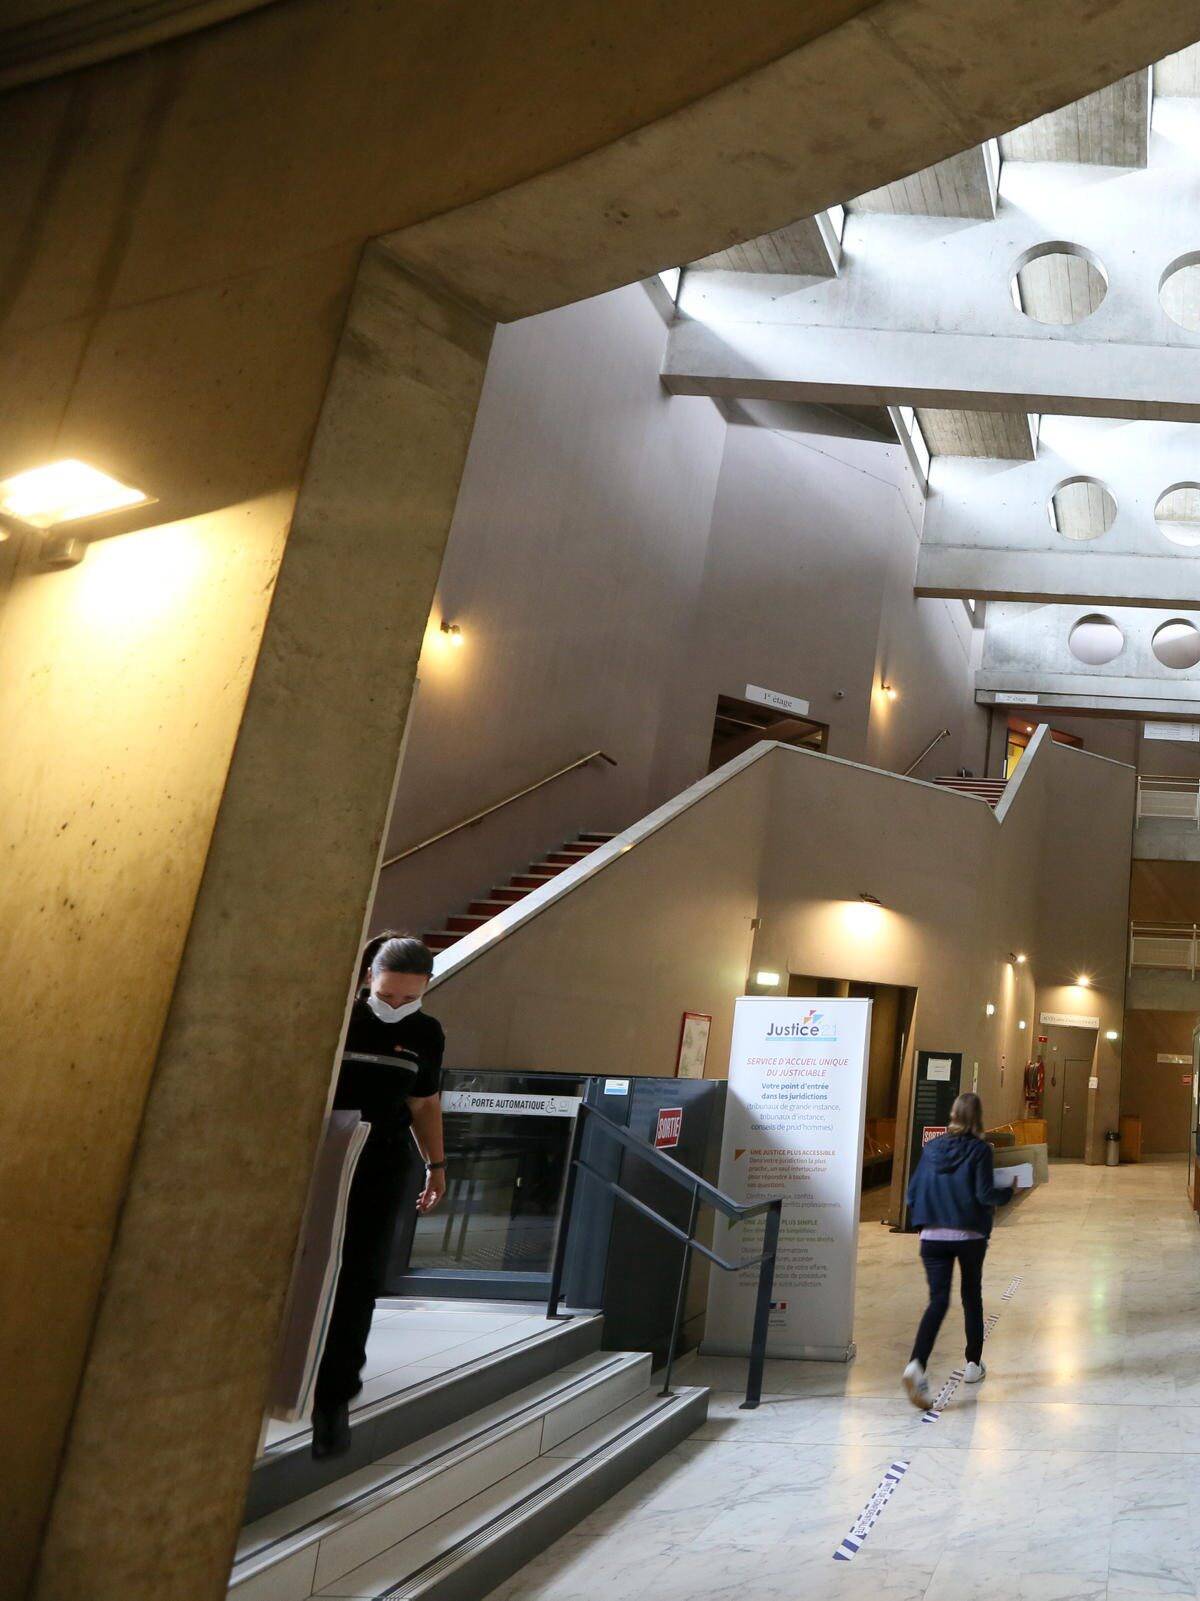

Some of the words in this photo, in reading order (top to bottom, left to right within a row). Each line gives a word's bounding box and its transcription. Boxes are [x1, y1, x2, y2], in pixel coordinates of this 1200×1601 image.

[766, 1022, 820, 1037] Justice
[747, 1057, 778, 1066] SERVICE
[779, 1057, 818, 1066] D'ACCUEIL
[819, 1058, 849, 1067] UNIQUE
[766, 1068, 778, 1077] DU
[779, 1068, 827, 1077] JUSTICIABLE
[761, 1082, 780, 1090] Votre
[781, 1082, 800, 1091] point
[801, 1081, 830, 1090] d'entrée
[761, 1092, 778, 1100] dans
[779, 1092, 789, 1100] les
[789, 1092, 828, 1101] juridictions
[471, 1098, 494, 1108] PORTE
[495, 1099, 545, 1110] AUTOMATIQUE
[657, 1116, 681, 1139] SORTIE
